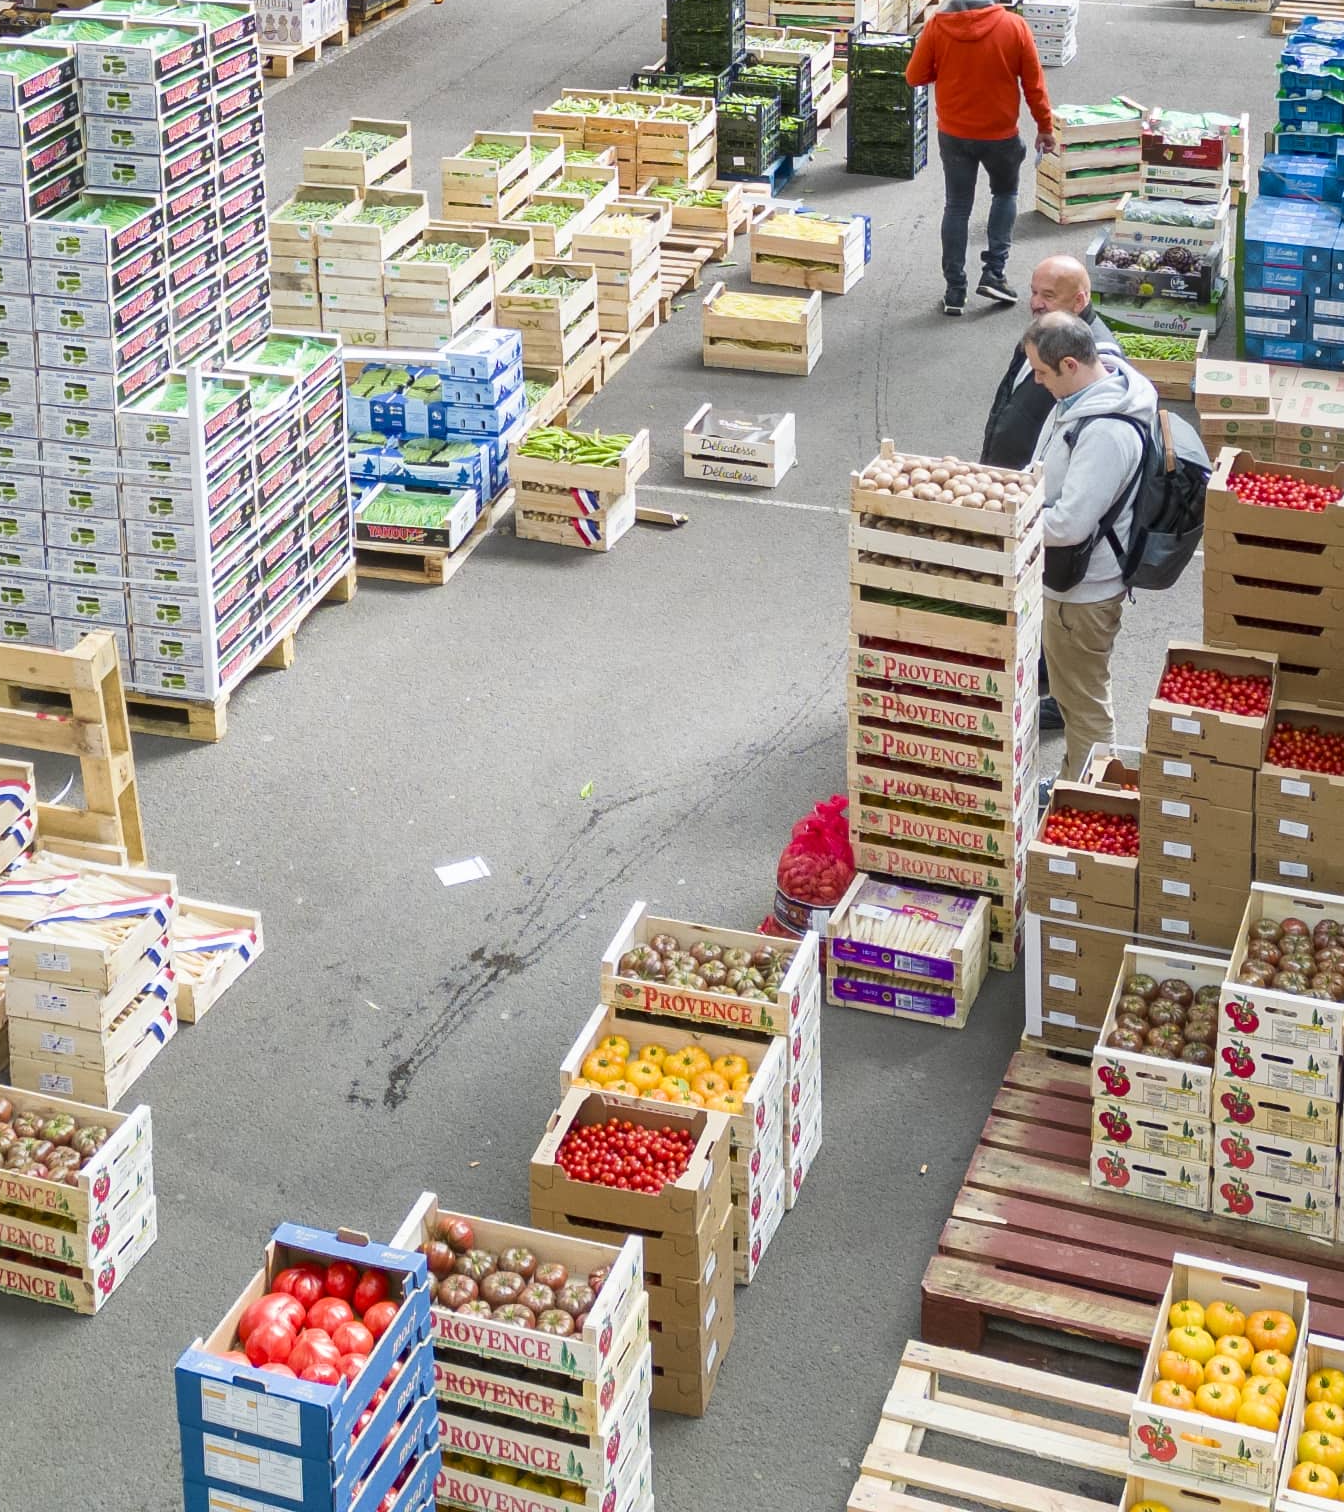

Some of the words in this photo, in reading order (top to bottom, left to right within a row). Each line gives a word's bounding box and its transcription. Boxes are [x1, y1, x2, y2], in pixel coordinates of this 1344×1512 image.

[882, 654, 981, 691] PROVENCE
[880, 693, 978, 731] PROVENCE
[880, 732, 977, 768] PROVENCE
[887, 812, 985, 850] PROVENCE
[886, 849, 984, 886] PROVENCE
[641, 983, 754, 1026] PROVENCE
